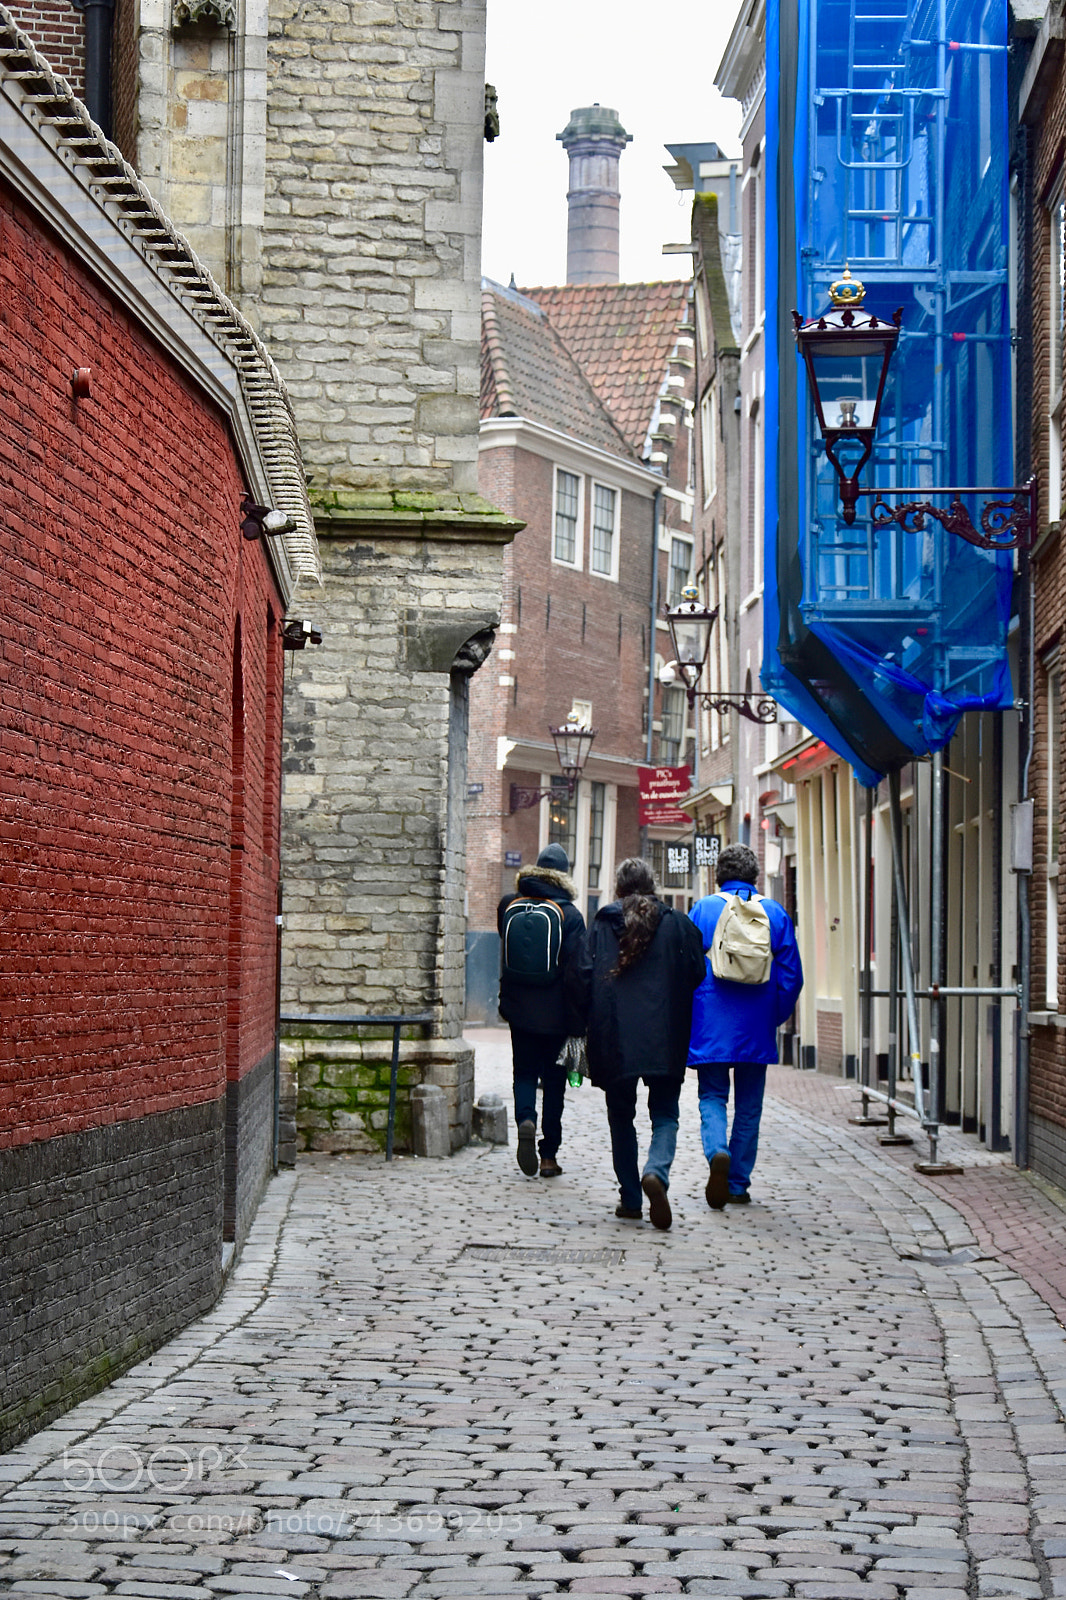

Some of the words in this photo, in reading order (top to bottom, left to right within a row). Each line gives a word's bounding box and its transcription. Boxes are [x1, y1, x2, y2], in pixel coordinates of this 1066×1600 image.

[650, 790, 659, 799] de
[695, 837, 719, 850] RLR
[668, 847, 689, 860] RLR
